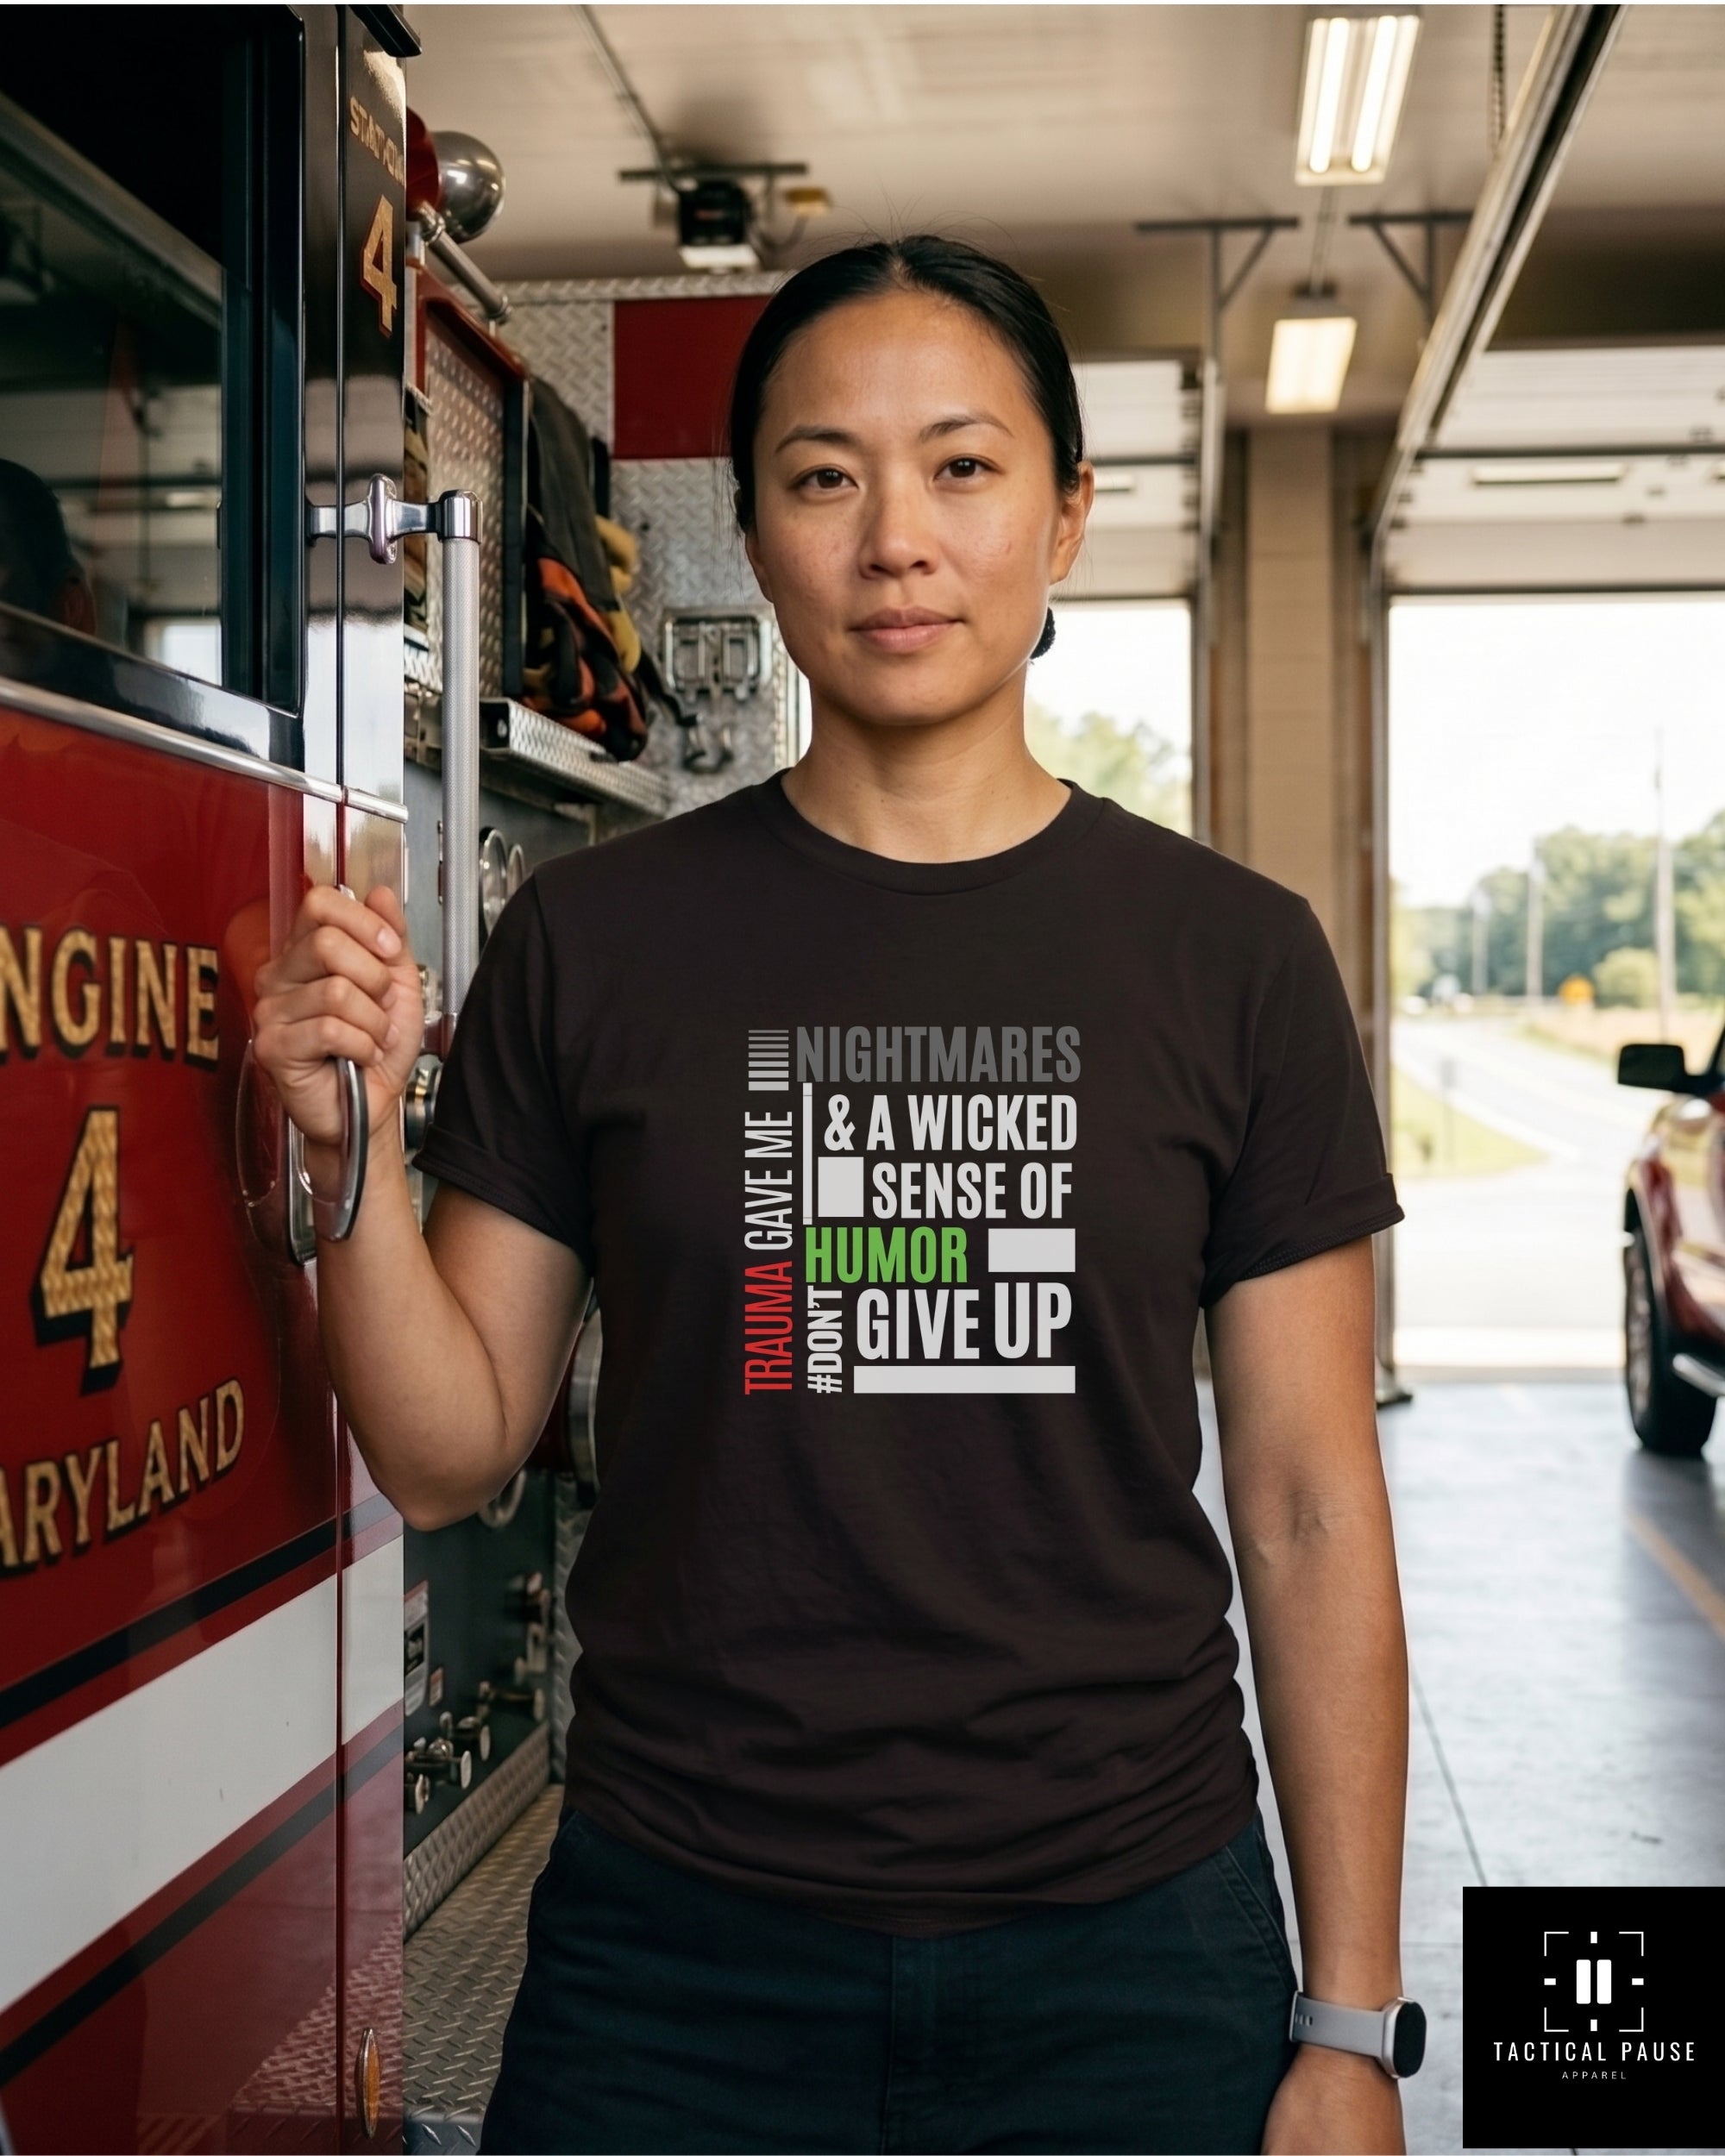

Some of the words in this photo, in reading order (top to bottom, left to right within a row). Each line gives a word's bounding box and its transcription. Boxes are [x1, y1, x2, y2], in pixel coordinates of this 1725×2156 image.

[361, 194, 398, 337] 4
[796, 1025, 1082, 1082] NIGHTMARES
[744, 1111, 793, 1158] ME
[824, 1094, 856, 1151] &
[866, 1094, 895, 1151] A
[906, 1094, 1077, 1151] WICKED
[744, 1169, 794, 1250] GAVE
[872, 1162, 1007, 1219] SENSE
[1020, 1162, 1073, 1219] OF
[36, 1107, 134, 1380] 4
[806, 1225, 968, 1283] HUMOR
[744, 1261, 794, 1395] TRAUMA
[806, 1285, 844, 1394] #DON'T
[856, 1288, 980, 1360] GIVE
[994, 1282, 1072, 1359] UP
